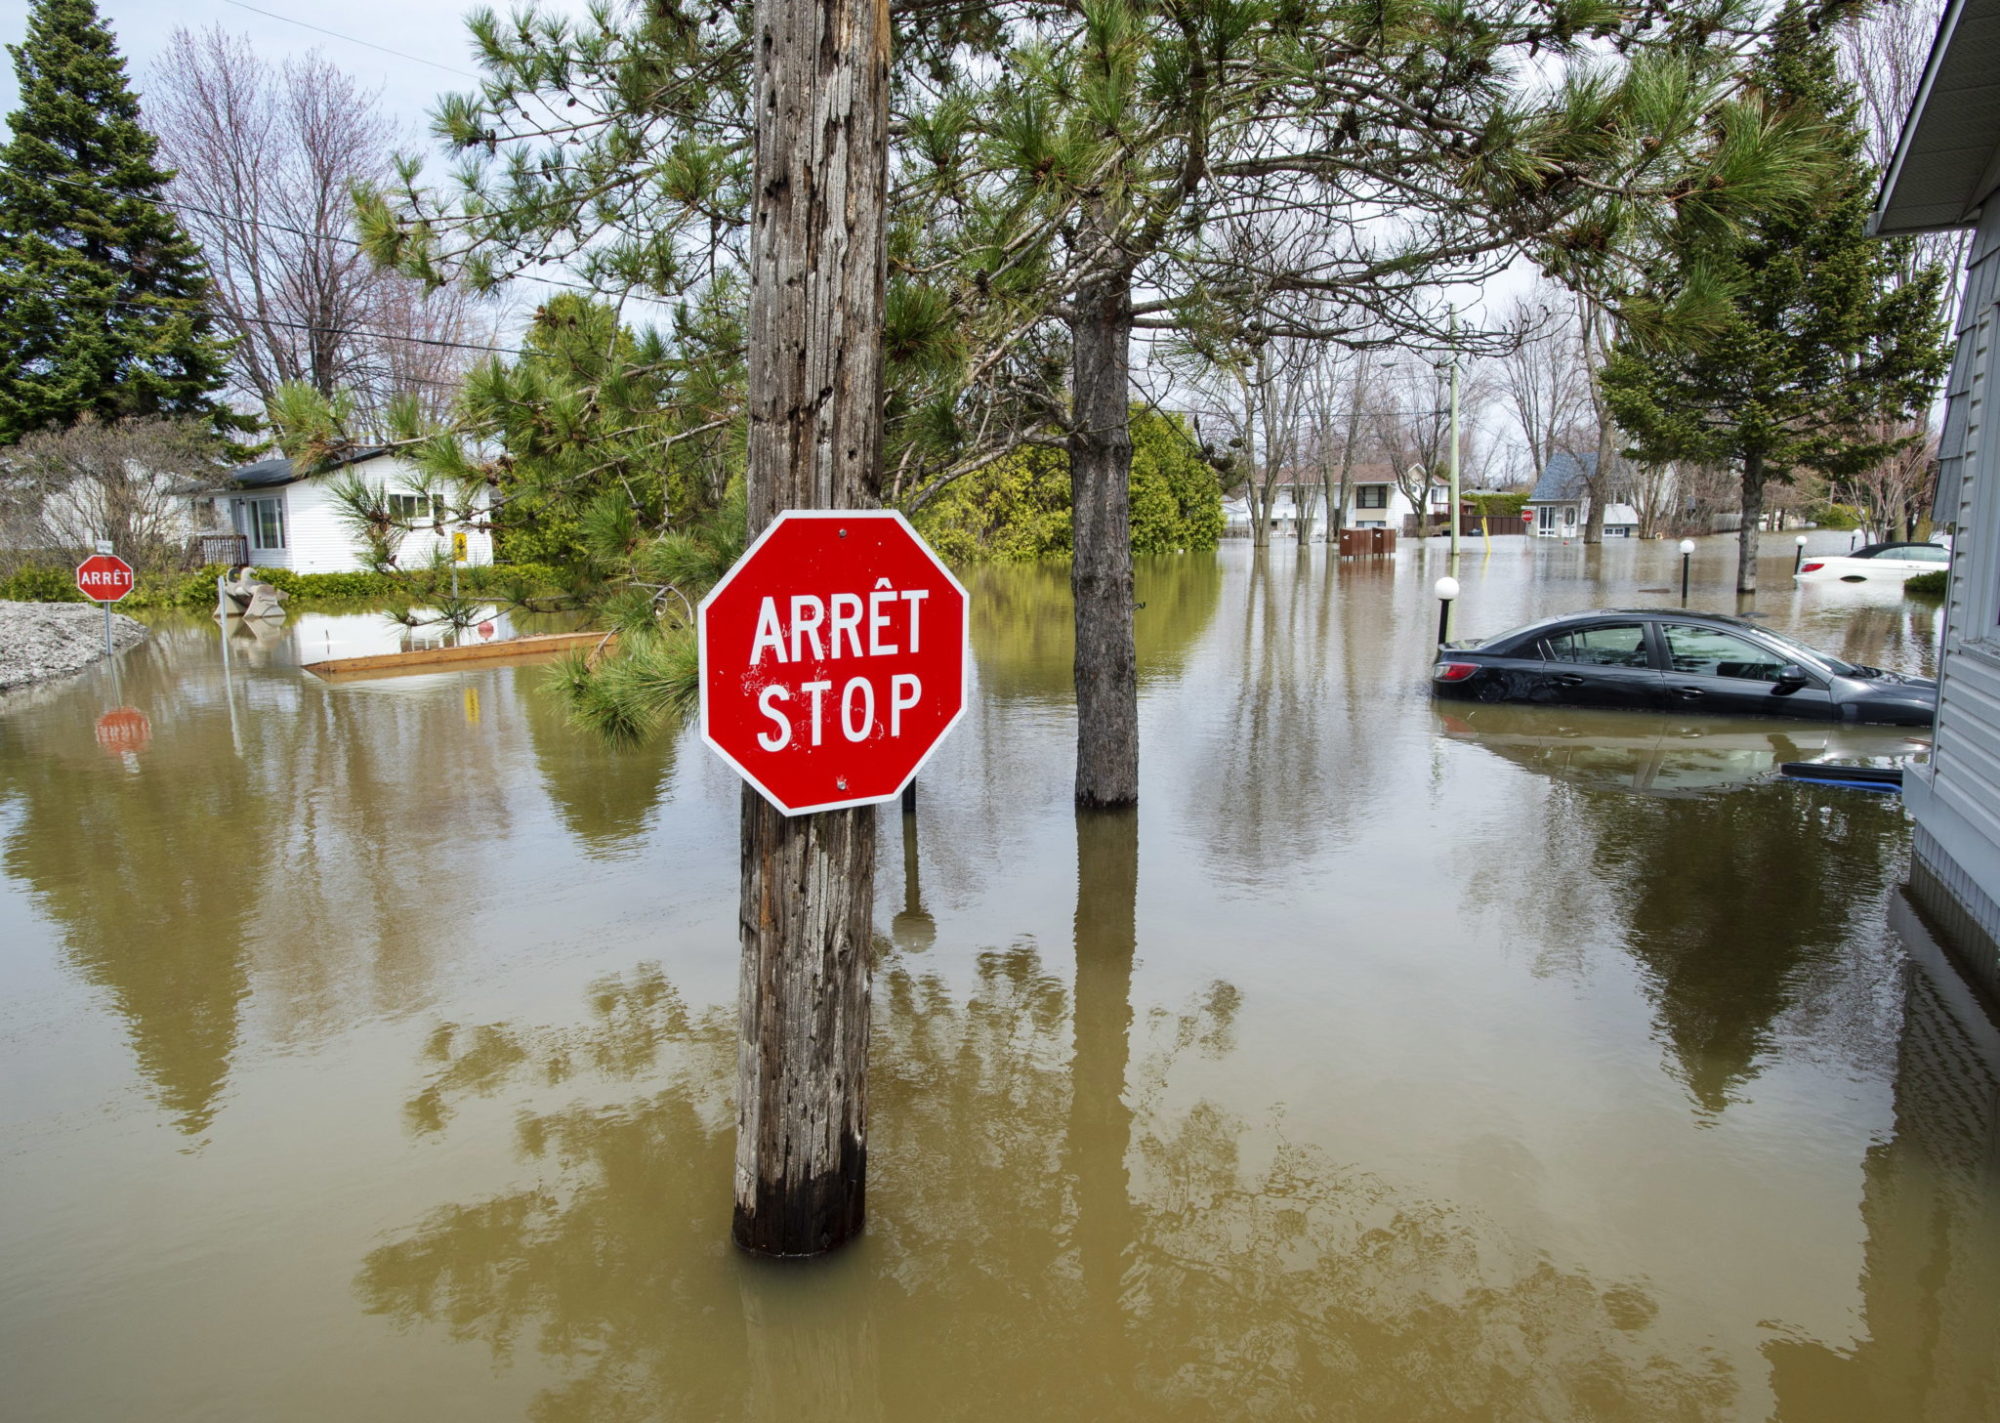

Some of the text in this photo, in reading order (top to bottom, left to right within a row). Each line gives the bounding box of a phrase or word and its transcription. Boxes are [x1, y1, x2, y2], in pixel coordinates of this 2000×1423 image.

[81, 569, 131, 585] ARRÊT
[749, 577, 929, 665] ARRÊT
[757, 673, 922, 752] STOP
